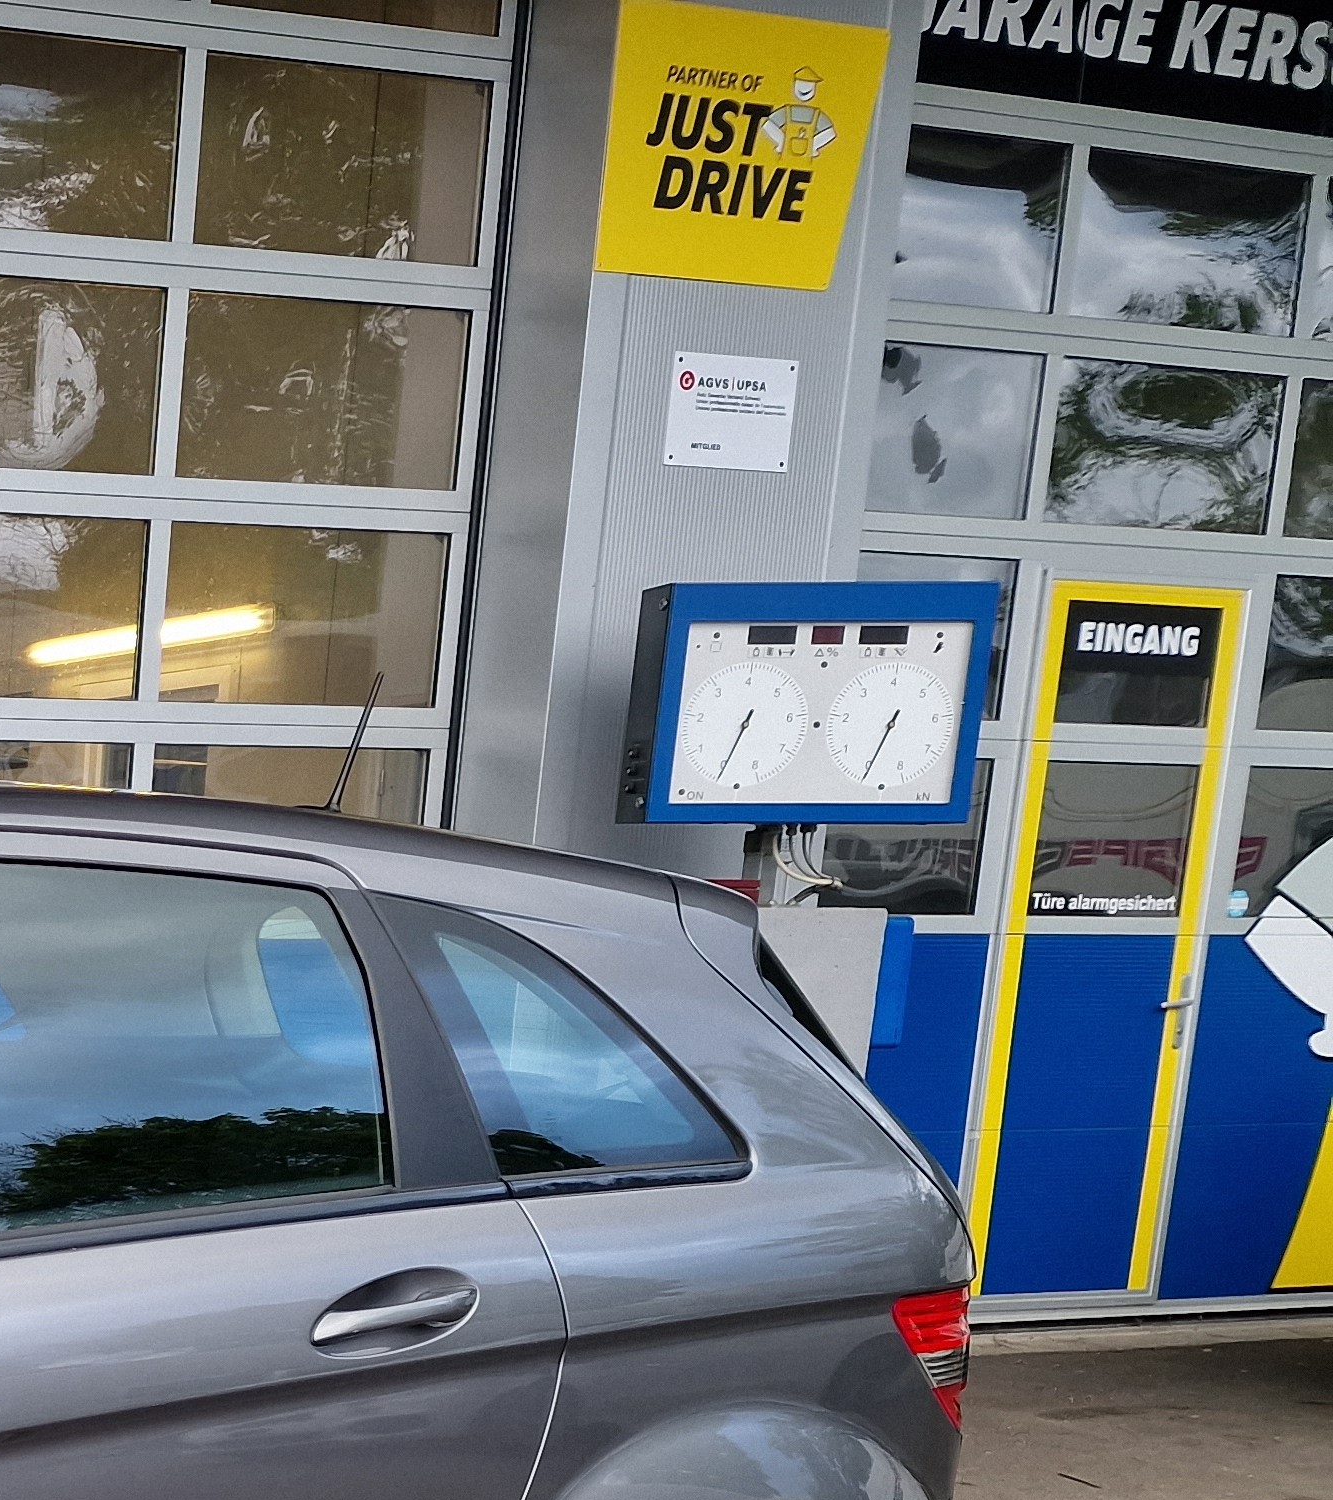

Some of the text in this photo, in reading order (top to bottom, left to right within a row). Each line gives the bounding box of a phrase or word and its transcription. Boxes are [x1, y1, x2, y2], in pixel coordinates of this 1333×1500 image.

[921, 0, 1333, 90] ARAGE KERS
[665, 65, 763, 92] PARTNER OF
[646, 92, 774, 156] JUST
[653, 155, 814, 222] DRIVE
[698, 376, 767, 392] AGVS UPSA
[1076, 620, 1201, 657] EINGANG
[745, 676, 752, 686] 4
[890, 676, 897, 687] 4
[714, 688, 722, 698] 3
[773, 688, 781, 698] 5
[860, 688, 868, 698] 3
[919, 688, 927, 698] 5
[697, 713, 704, 723] 2
[786, 712, 793, 723] 6
[842, 713, 850, 723] 2
[931, 713, 939, 723] 6
[751, 760, 759, 770] 8
[897, 760, 904, 771] 8
[686, 791, 704, 801] ON
[915, 791, 931, 802] kN
[1032, 893, 1177, 915] Türe alarmgesichert
